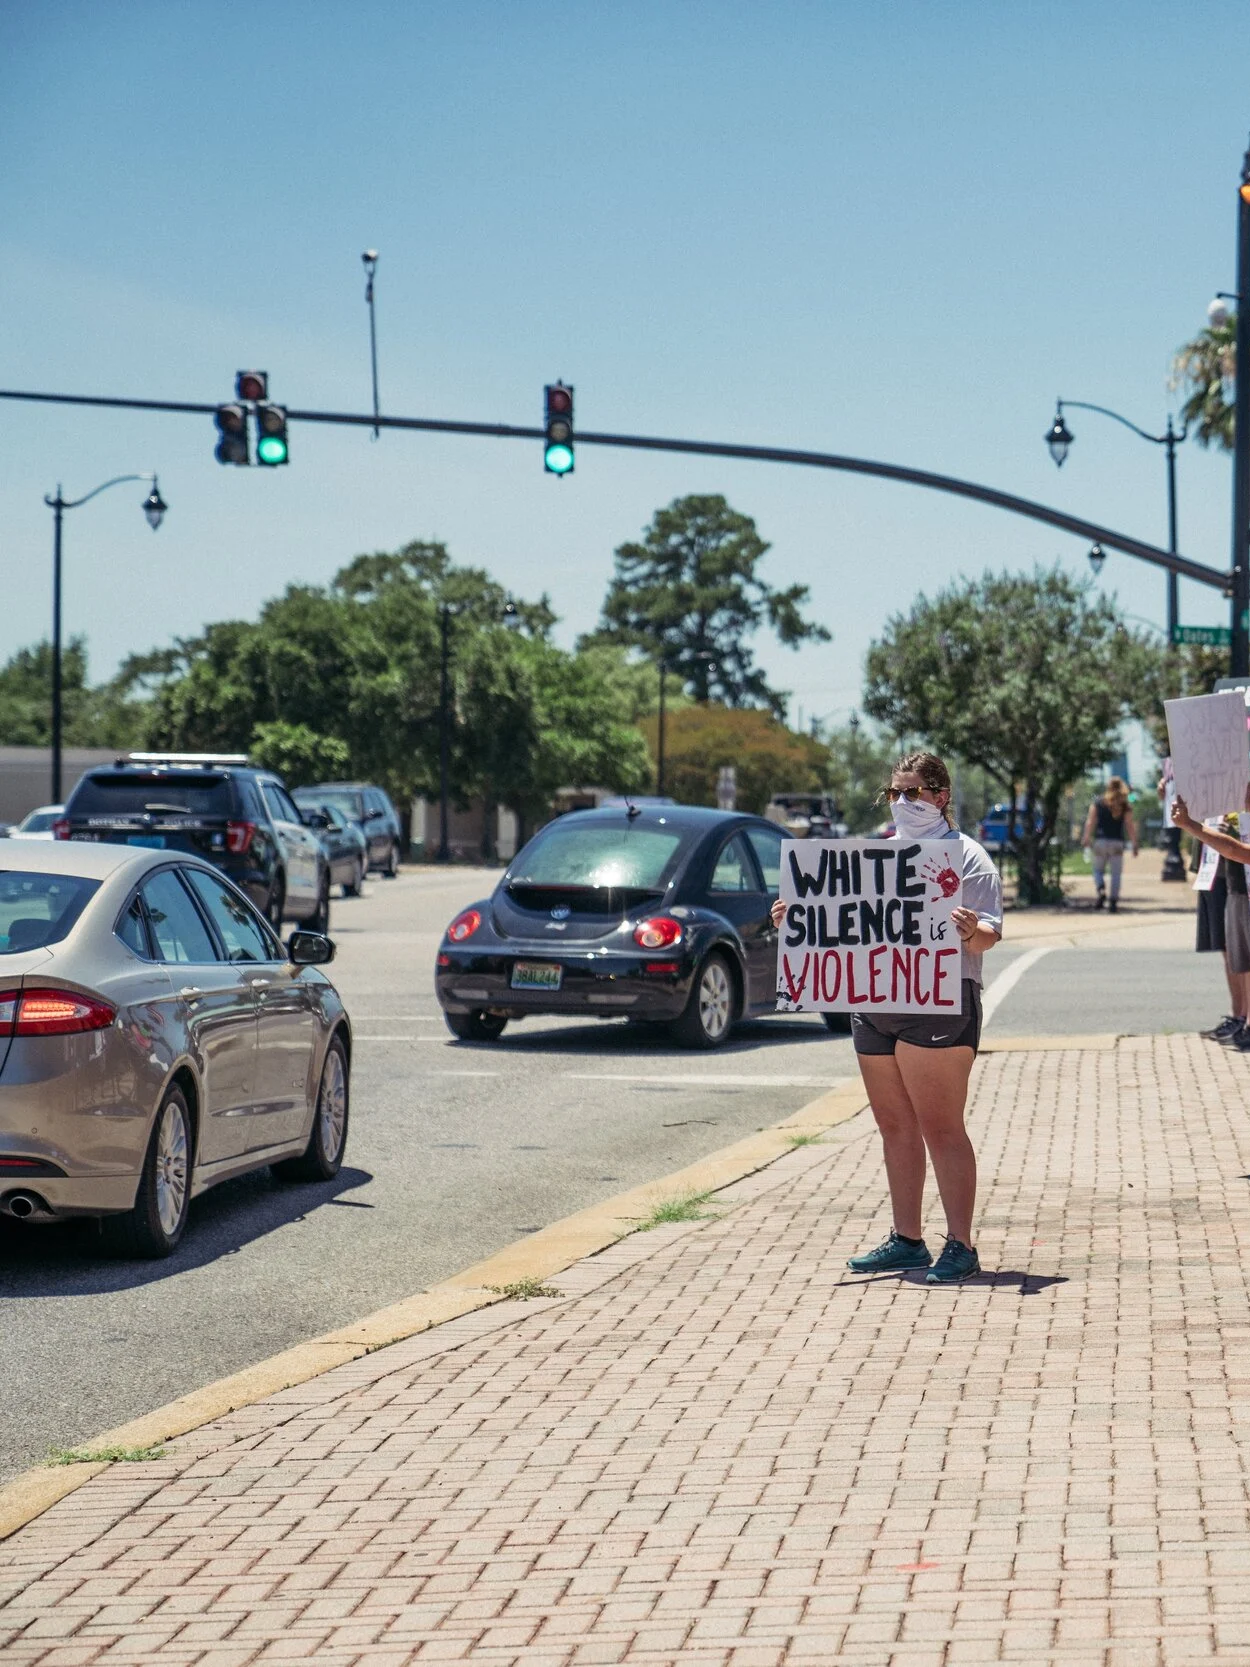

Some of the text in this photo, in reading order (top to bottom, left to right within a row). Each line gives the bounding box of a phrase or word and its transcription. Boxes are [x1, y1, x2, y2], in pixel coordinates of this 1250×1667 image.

[788, 844, 926, 898] WHITE
[784, 898, 947, 947] SILENCE is
[783, 945, 958, 1007] VIOLENCE
